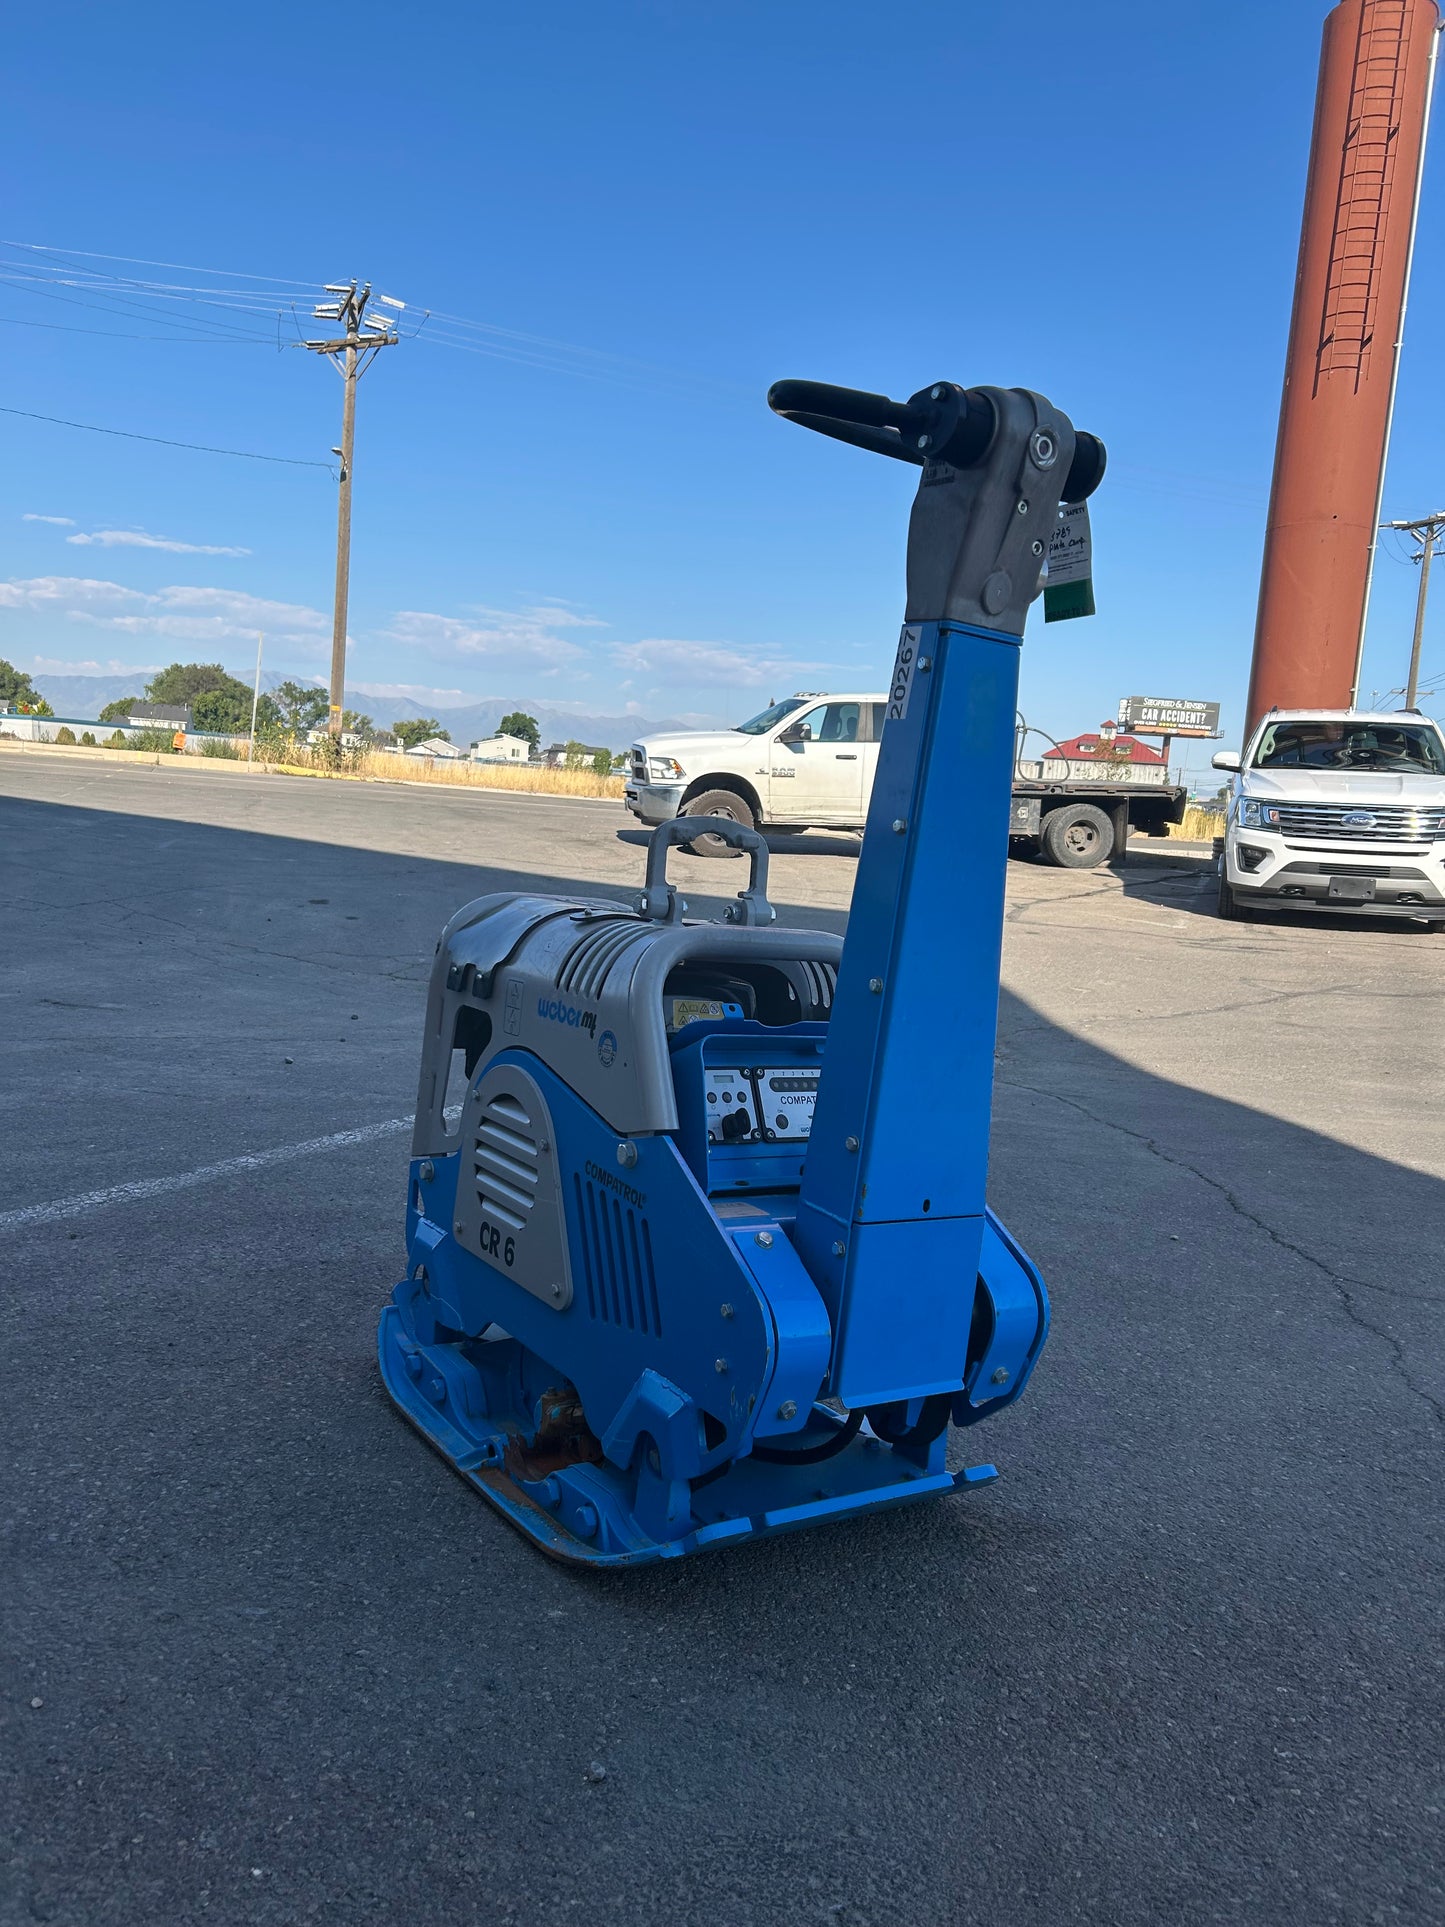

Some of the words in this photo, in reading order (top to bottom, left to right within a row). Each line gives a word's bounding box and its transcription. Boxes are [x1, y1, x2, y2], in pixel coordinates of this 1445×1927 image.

[1066, 507, 1085, 516] SAFETY
[890, 629, 916, 720] 20267
[1183, 700, 1207, 710] JENSEN
[1141, 708, 1158, 720] CAR
[1160, 709, 1207, 724] ACCIDENT?
[479, 1221, 501, 1259] CR
[504, 1236, 515, 1267] 6
